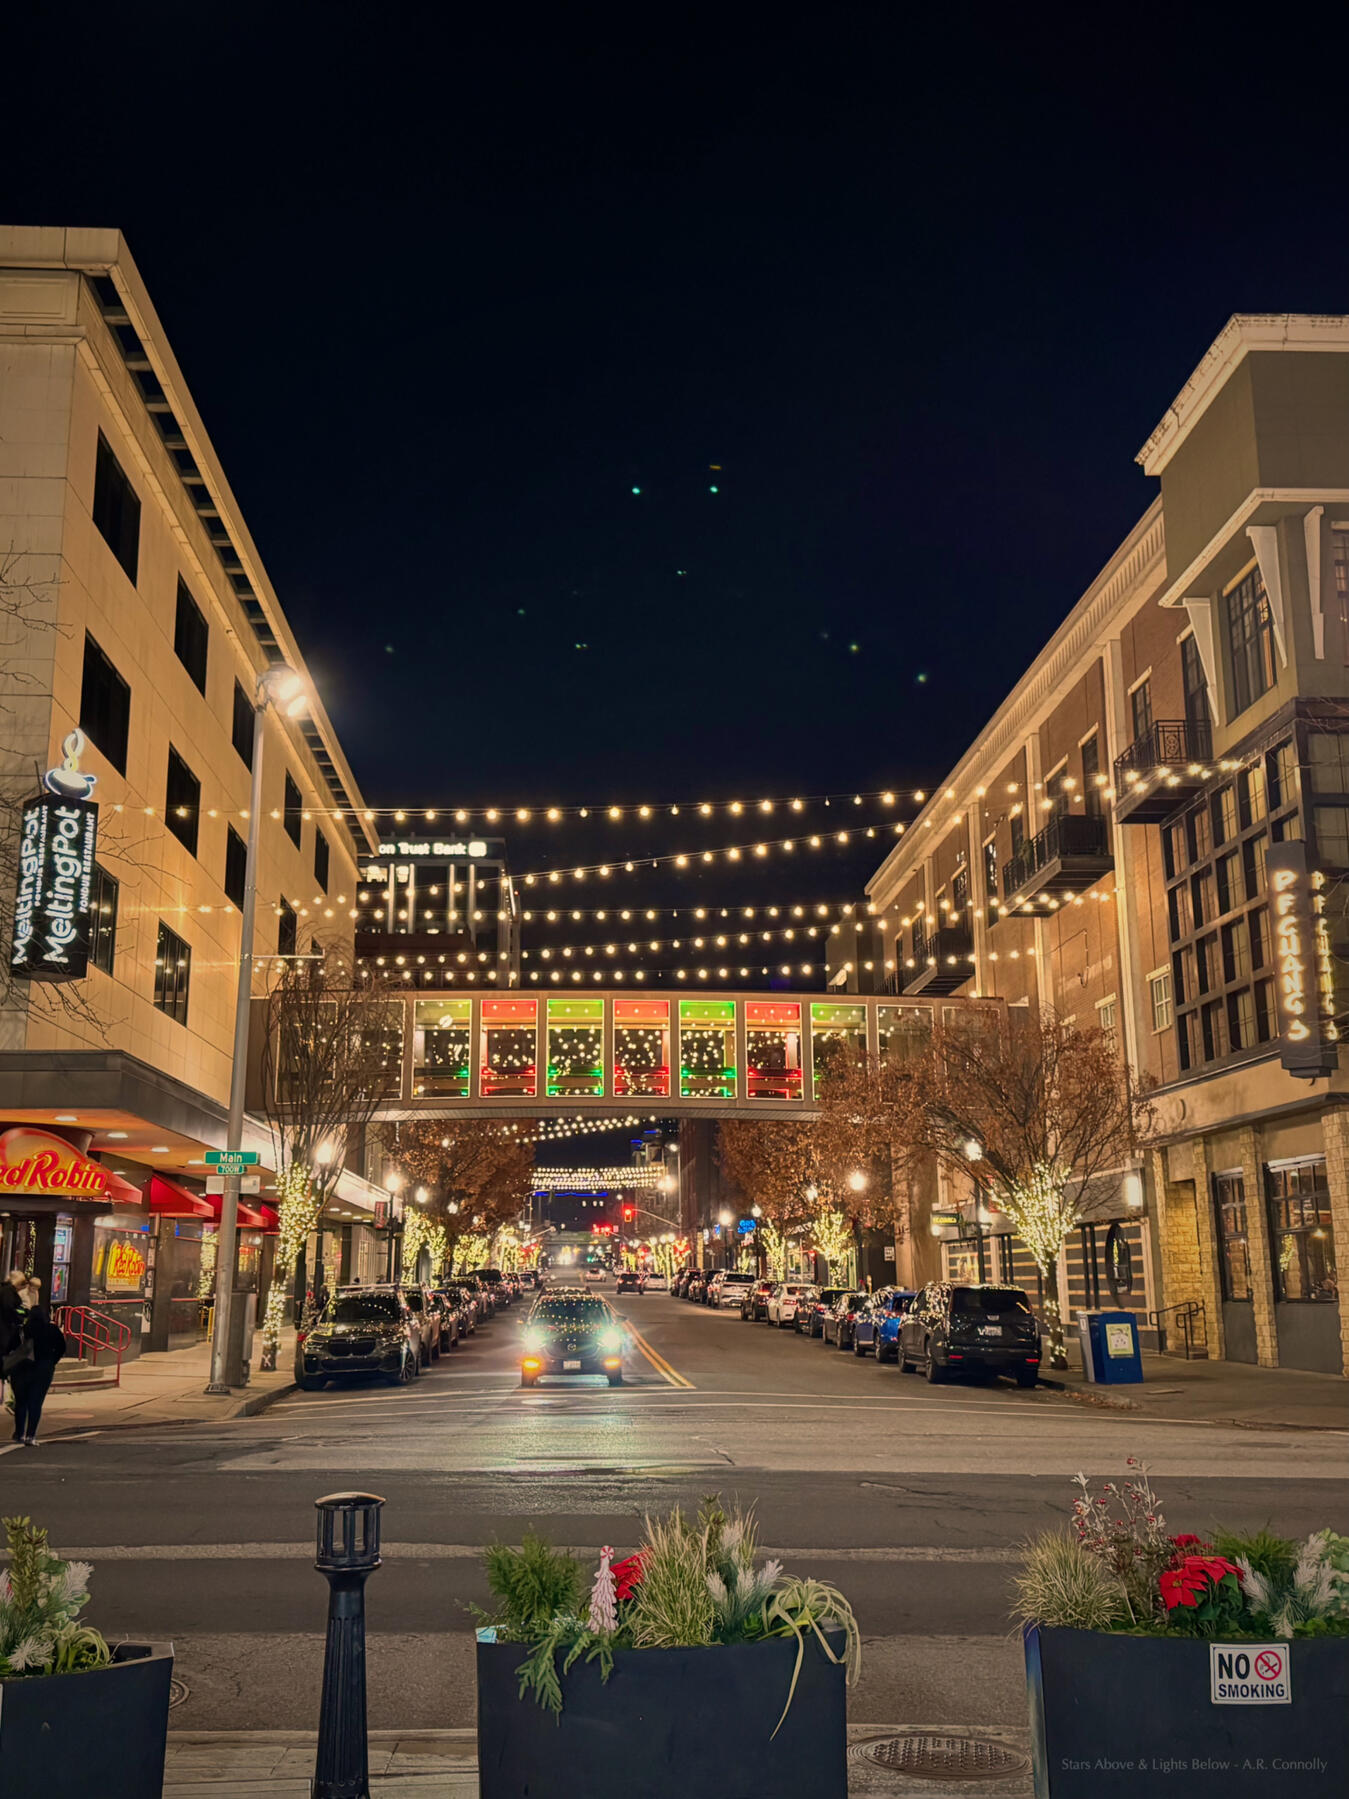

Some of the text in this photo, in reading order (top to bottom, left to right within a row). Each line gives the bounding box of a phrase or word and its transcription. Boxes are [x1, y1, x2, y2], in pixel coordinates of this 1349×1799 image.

[398, 842, 430, 855] Trust
[433, 842, 466, 855] Bank
[78, 812, 96, 914] FONDUE RESTAURANT
[219, 1152, 243, 1163] Main
[25, 1150, 106, 1190] Robin
[1217, 1653, 1250, 1680] NO
[1217, 1683, 1285, 1698] SMOKING
